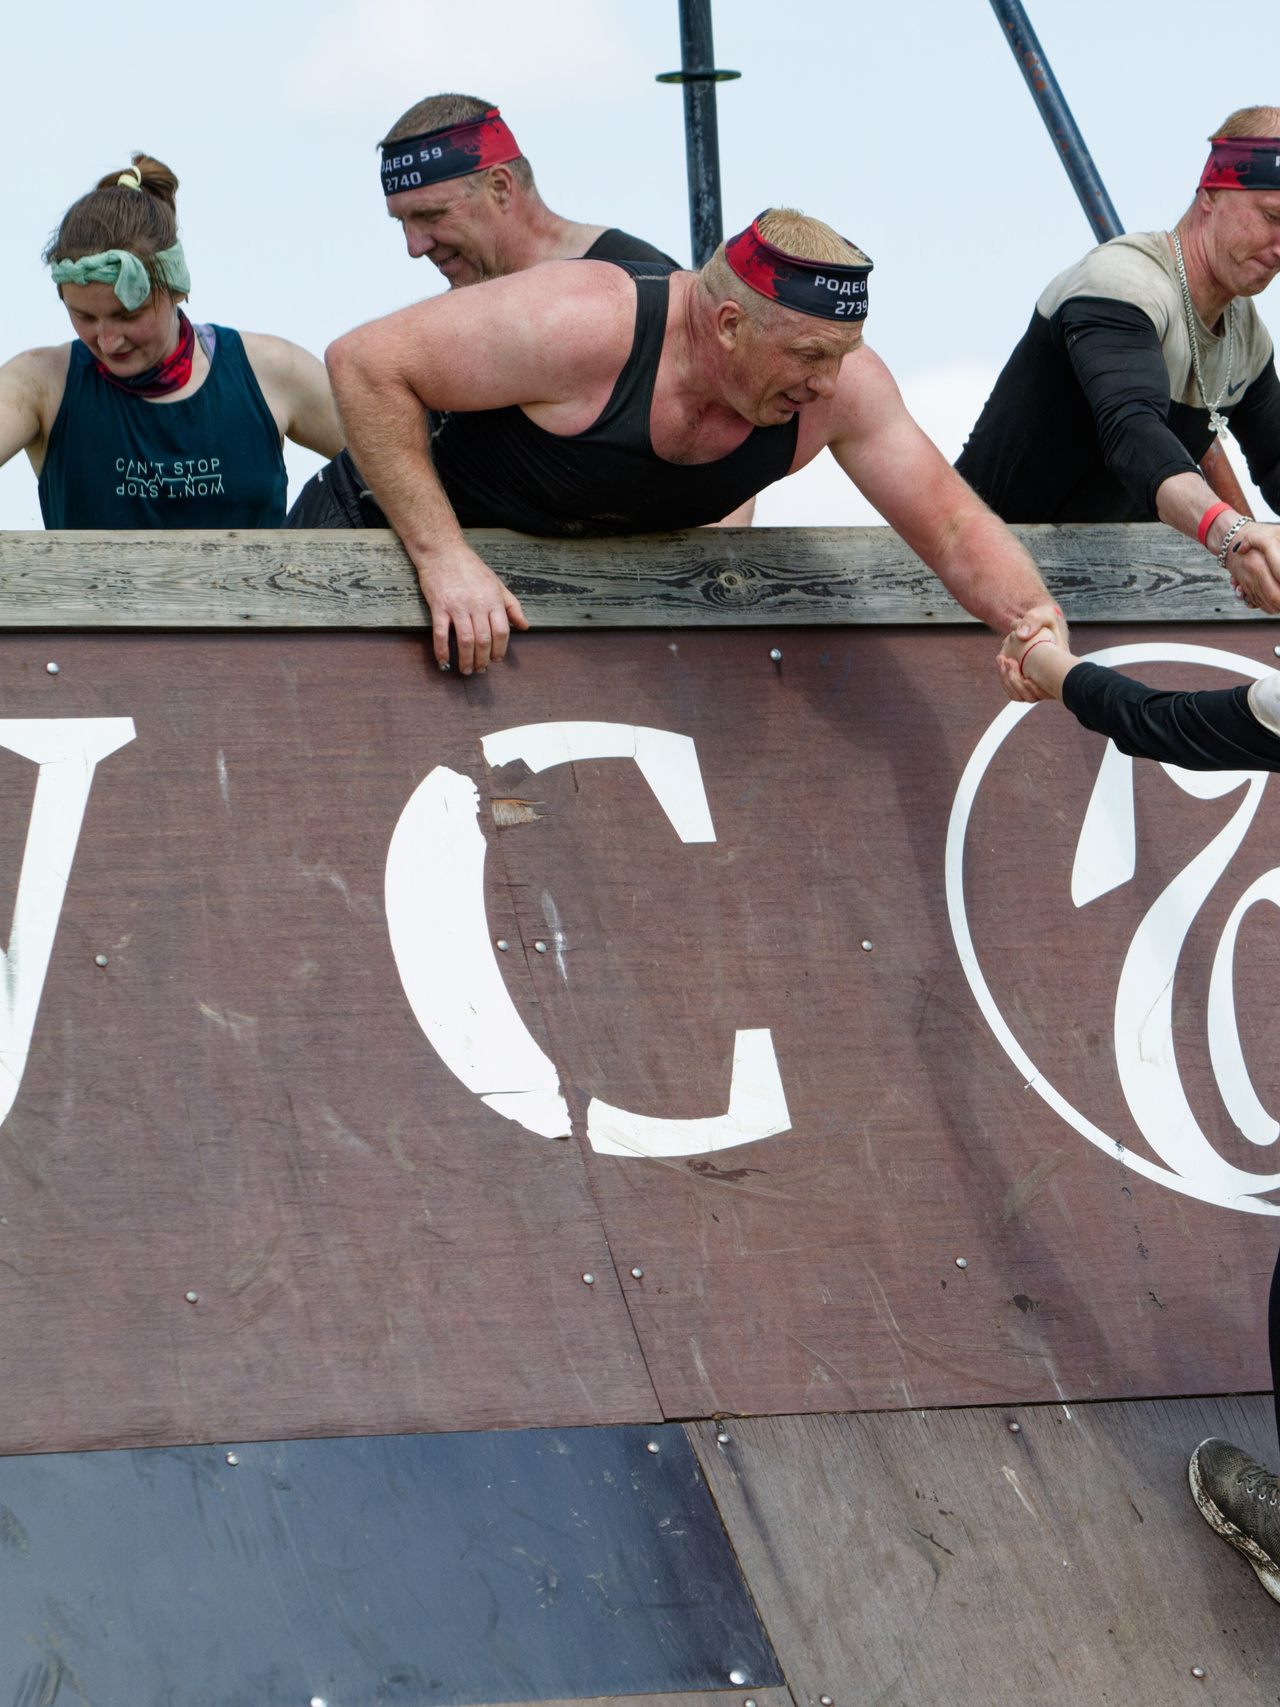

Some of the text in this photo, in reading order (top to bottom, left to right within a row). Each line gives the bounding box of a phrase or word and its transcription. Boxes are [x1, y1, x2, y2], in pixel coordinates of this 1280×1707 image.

[420, 146, 443, 163] 59
[385, 171, 422, 192] 2740
[814, 275, 866, 296] РОДЕО
[834, 299, 868, 315] 2739
[115, 457, 220, 479] CAN'T STOP
[115, 480, 225, 499] WON'T STOP
